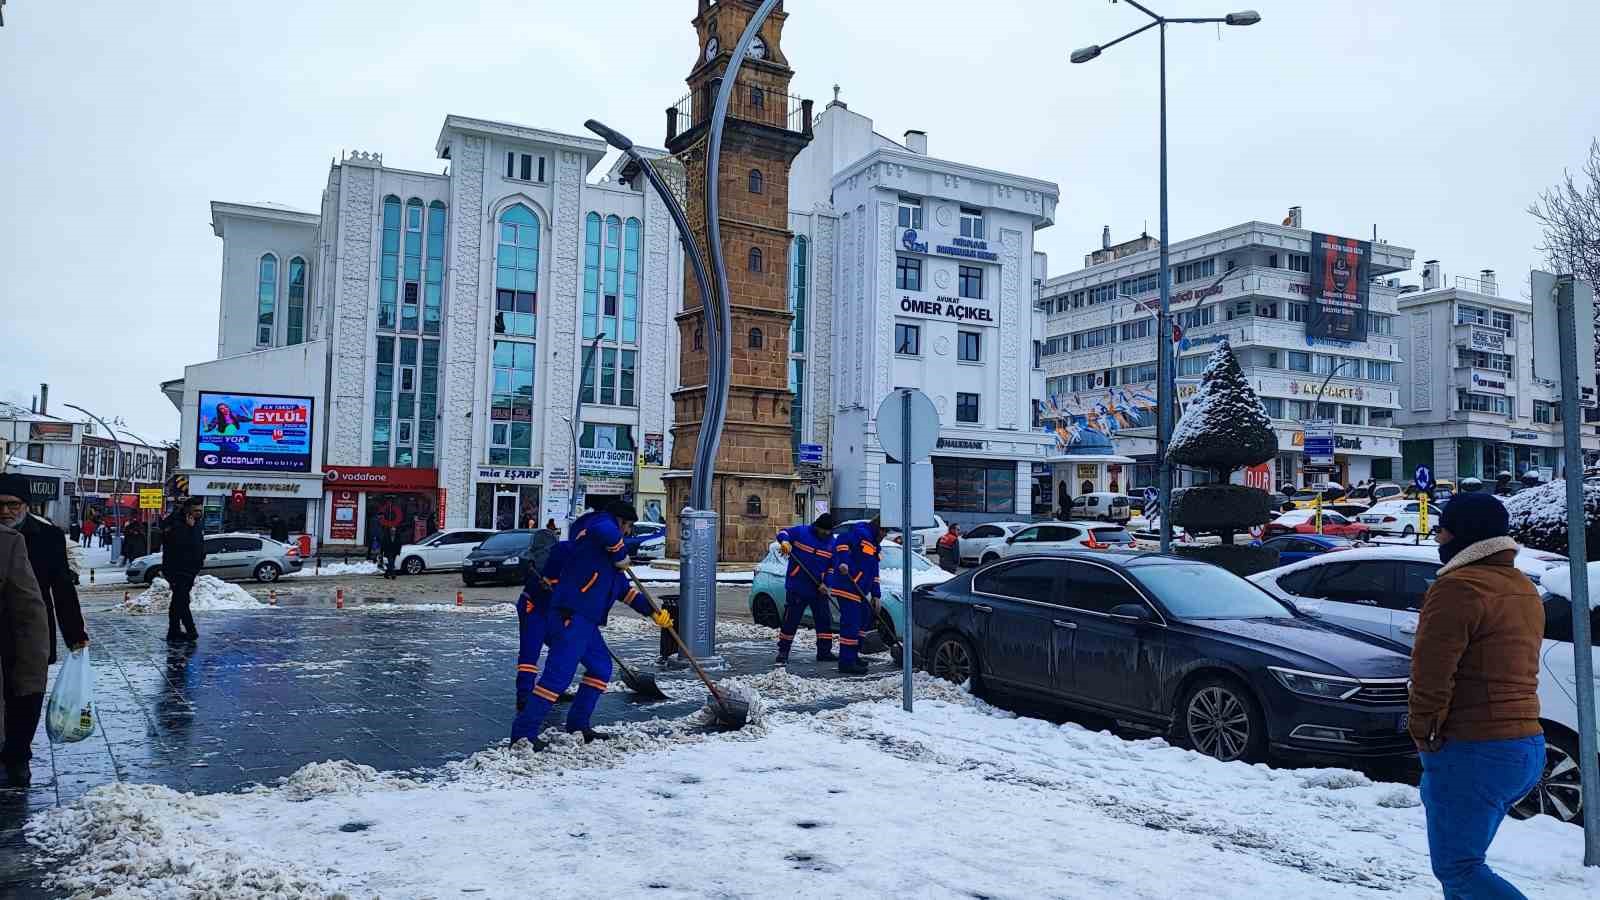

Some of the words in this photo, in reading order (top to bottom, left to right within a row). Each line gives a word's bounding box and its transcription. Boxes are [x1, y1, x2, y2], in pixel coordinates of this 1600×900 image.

[936, 295, 960, 304] AVUKAT
[900, 296, 942, 315] ÖMER
[945, 304, 993, 321] AÇIKEL
[254, 410, 305, 422] EYLÜL
[342, 472, 386, 481] vodafone
[480, 469, 501, 478] mia
[504, 470, 540, 480] EŞARP
[1247, 471, 1269, 489] DUR
